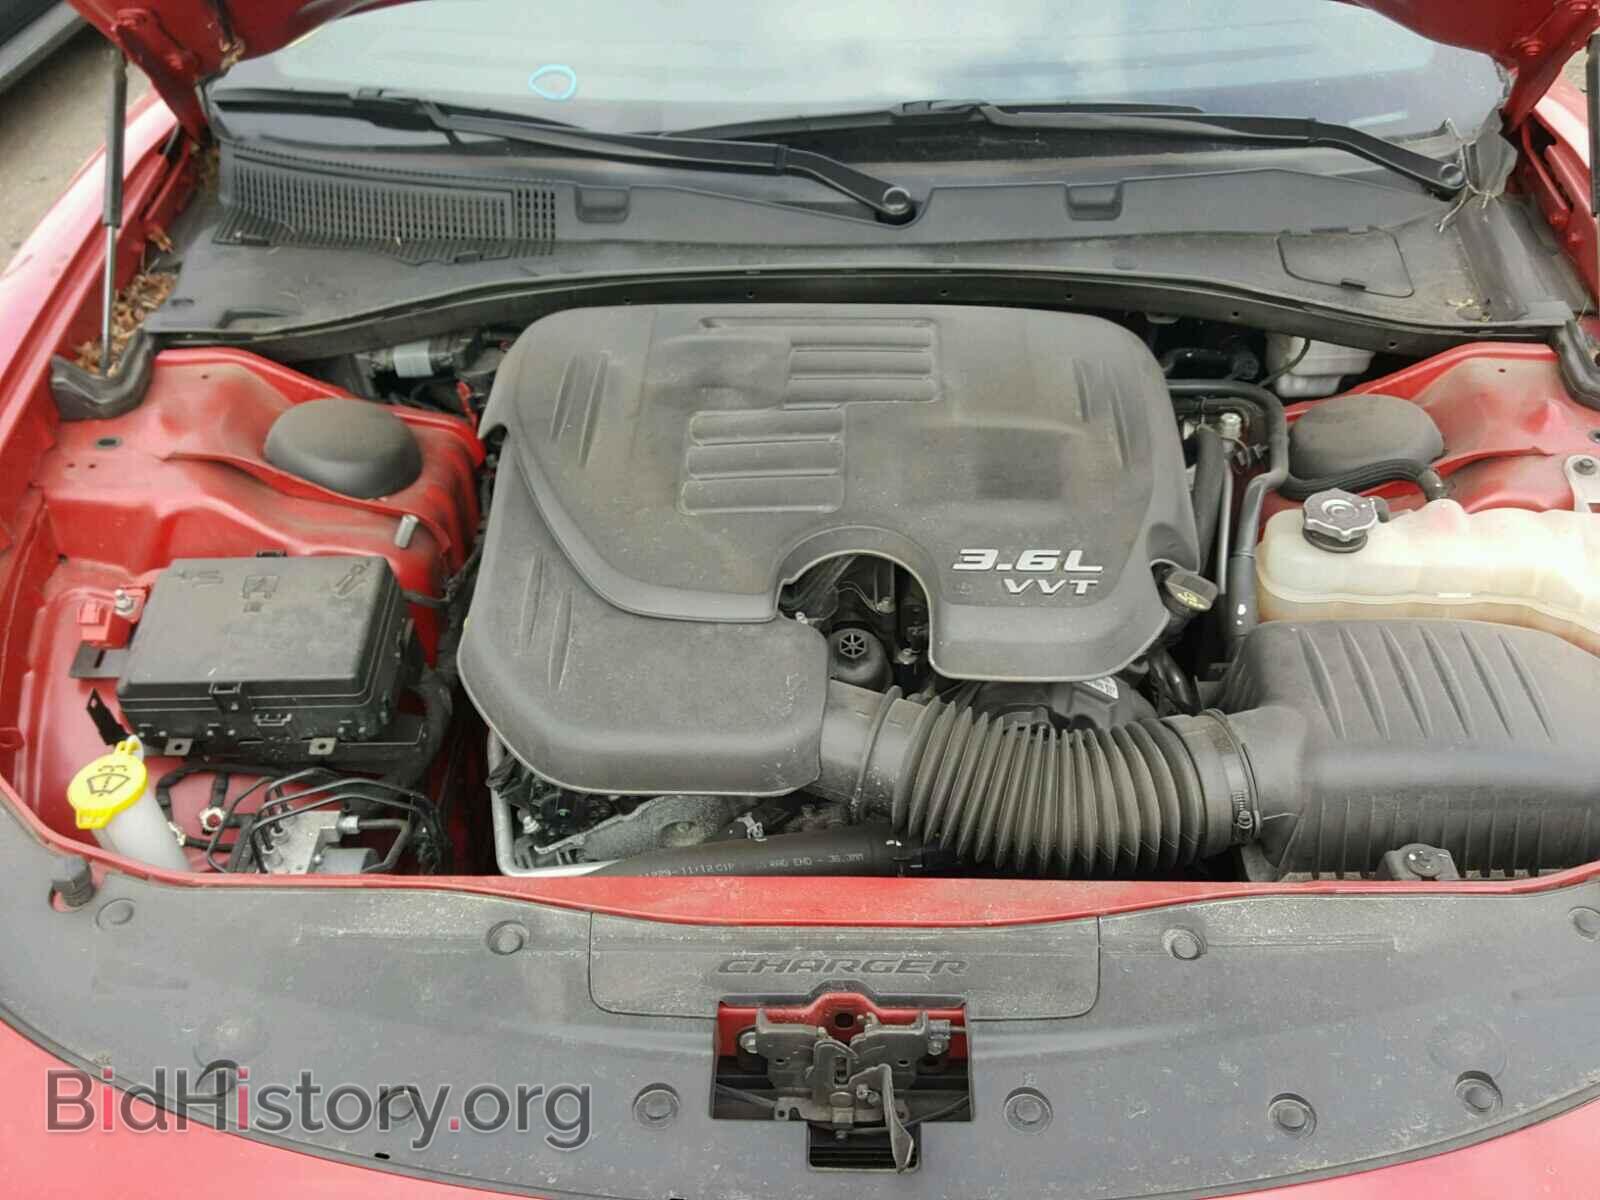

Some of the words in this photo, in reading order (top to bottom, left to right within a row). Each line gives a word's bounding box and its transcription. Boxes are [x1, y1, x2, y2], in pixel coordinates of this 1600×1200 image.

[952, 549, 1103, 572] 3.6L
[1003, 578, 1099, 595] VVT
[717, 959, 969, 975] CHARGER
